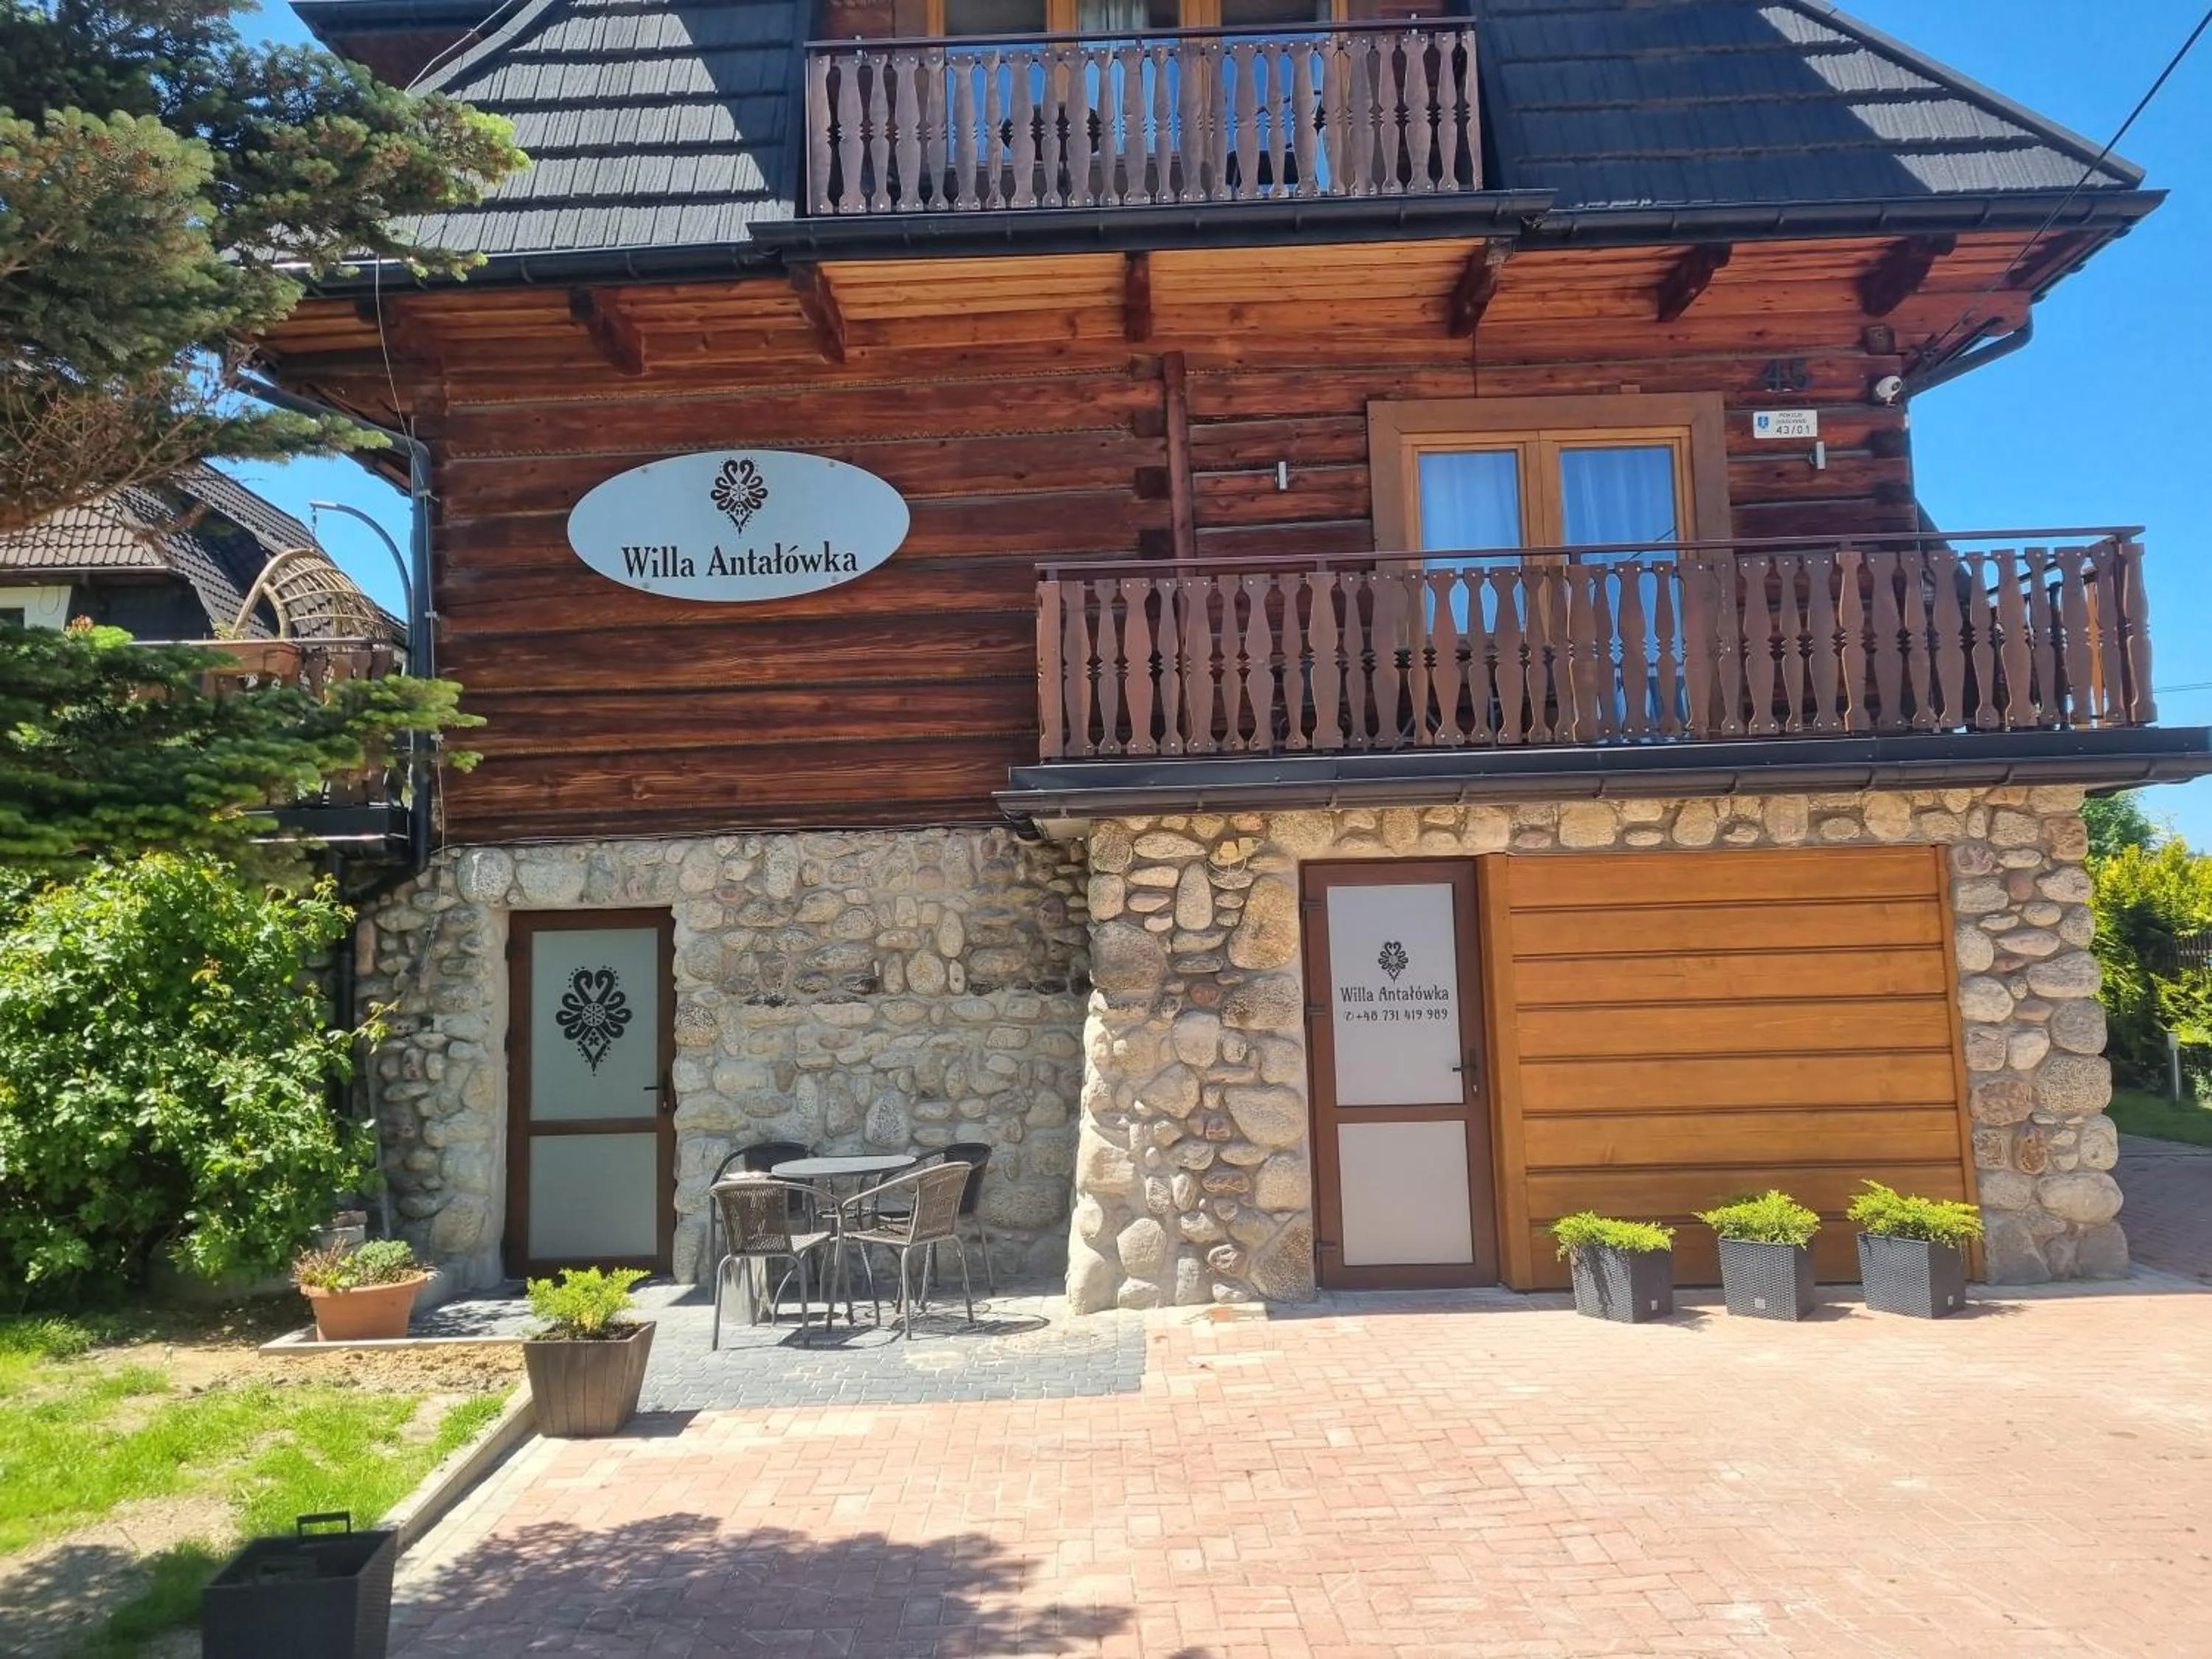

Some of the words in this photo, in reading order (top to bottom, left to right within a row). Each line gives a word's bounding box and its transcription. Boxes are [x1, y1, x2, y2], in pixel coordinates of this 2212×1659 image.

[1776, 425, 1809, 434] 43/01
[621, 546, 695, 578] Willa
[706, 541, 858, 577] Antałówka
[1340, 987, 1374, 1002] Willa
[1378, 985, 1450, 1002] Antałówka
[1356, 1009, 1378, 1021] +48
[1382, 1009, 1399, 1021] 731
[1405, 1009, 1422, 1021] 419
[1427, 1008, 1448, 1020] 989
